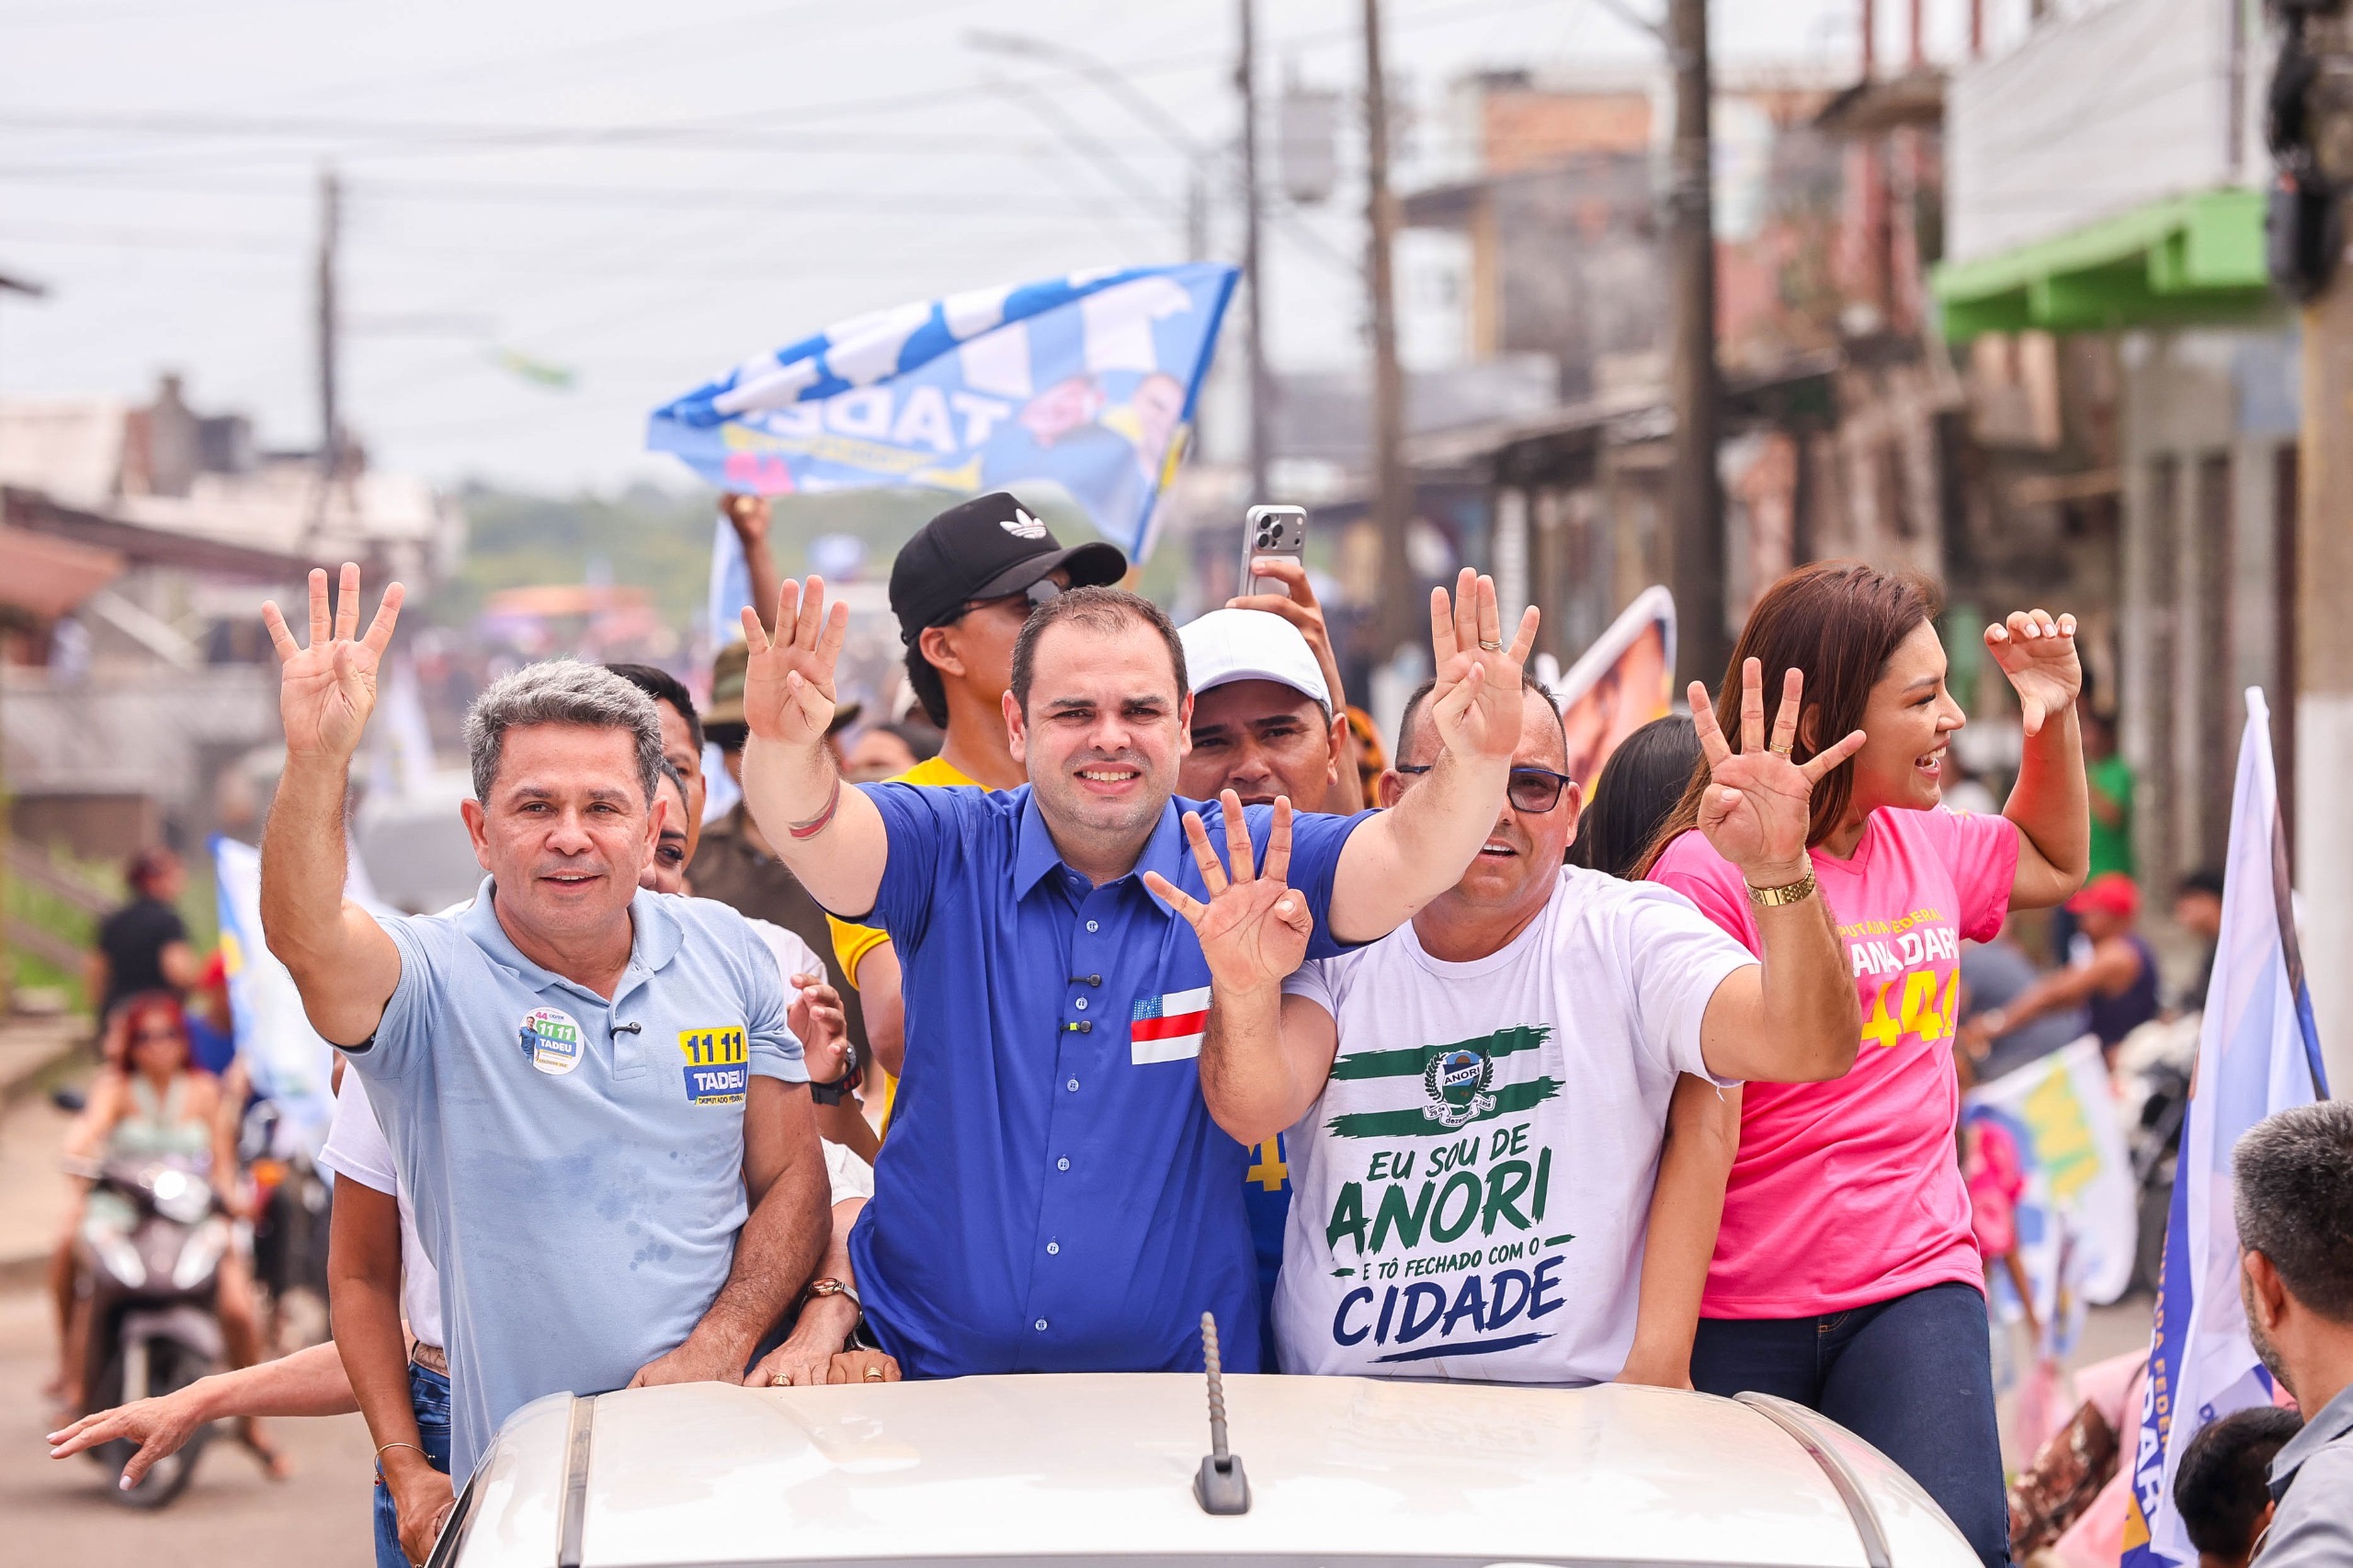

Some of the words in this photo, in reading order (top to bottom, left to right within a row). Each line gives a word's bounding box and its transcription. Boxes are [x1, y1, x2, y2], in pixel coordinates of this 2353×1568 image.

[1838, 921, 1890, 937] PUTADA
[1891, 908, 1944, 934] EDERAL
[1851, 941, 1904, 977] ANA
[536, 1012, 548, 1020] 44
[540, 1039, 572, 1052] TADEU
[693, 1070, 745, 1091] TADEU
[1445, 1067, 1480, 1085] ANORI
[1367, 1151, 1415, 1181] EU
[1426, 1136, 1480, 1177] SOU
[1489, 1123, 1531, 1161] DE
[1326, 1146, 1552, 1260] ANORI
[1363, 1264, 1371, 1280] E
[1379, 1258, 1398, 1279] TÔ
[1405, 1249, 1483, 1278] FECHADO
[1488, 1242, 1523, 1264] COM
[1529, 1237, 1539, 1256] O
[1333, 1256, 1567, 1346] CIDADE
